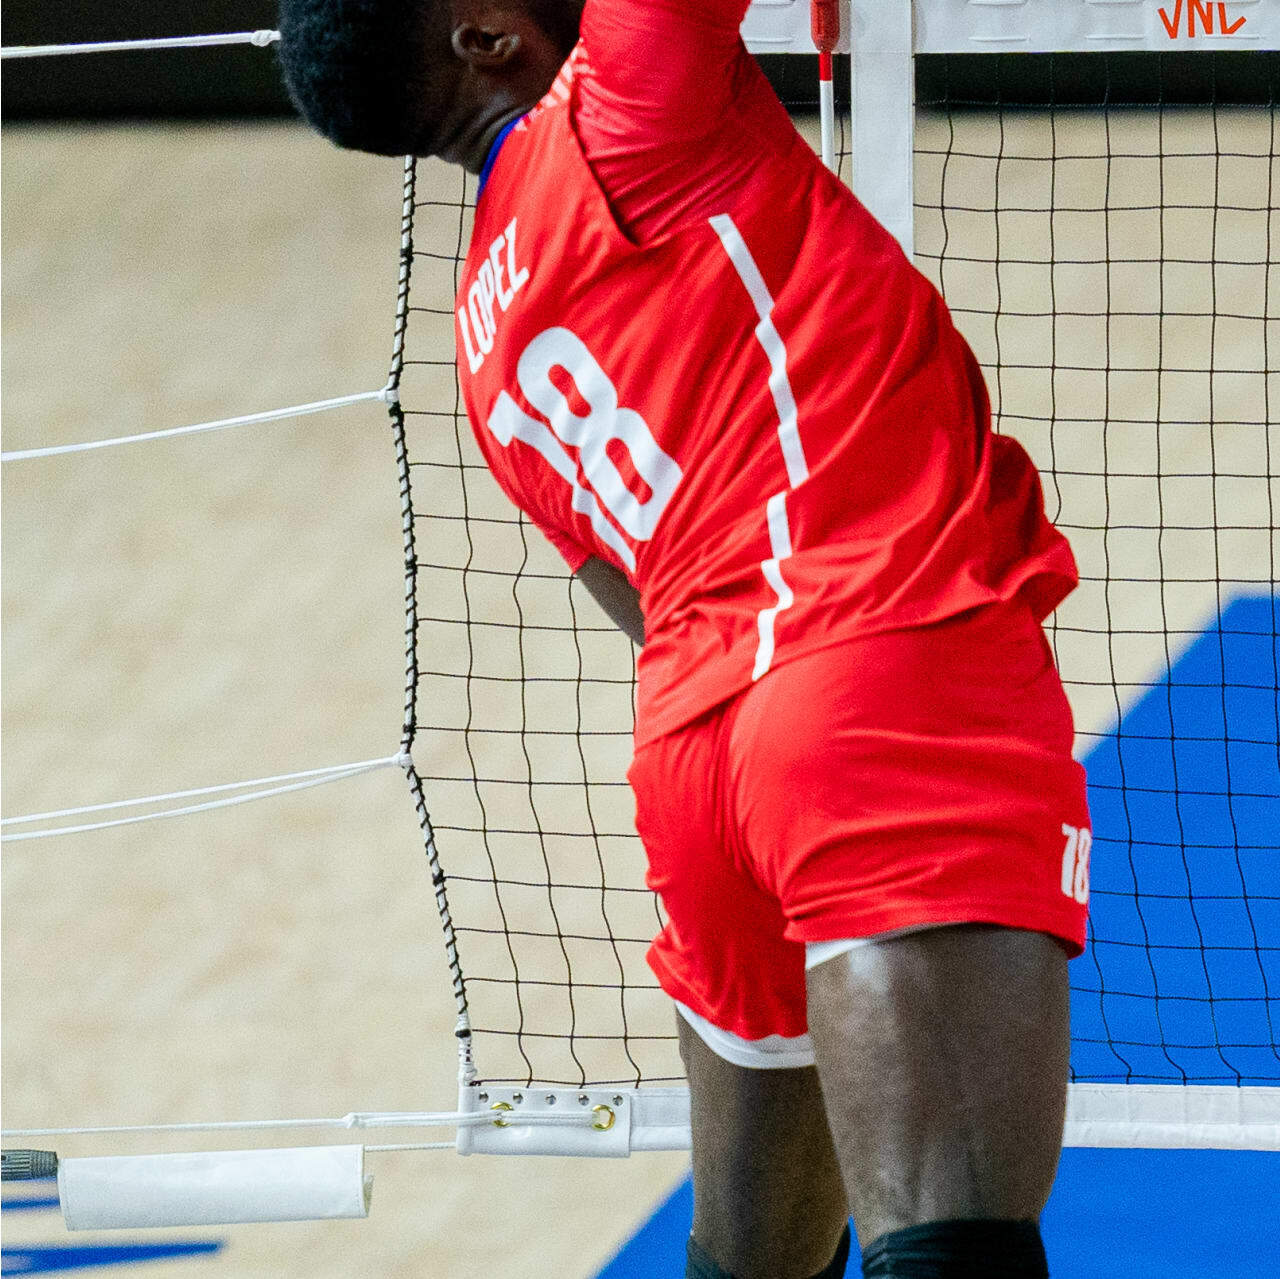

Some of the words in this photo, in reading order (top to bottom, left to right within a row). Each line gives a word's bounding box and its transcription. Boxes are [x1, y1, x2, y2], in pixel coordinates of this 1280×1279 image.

[457, 217, 530, 374] LOPEZ
[487, 326, 684, 573] 18
[1061, 822, 1092, 904] 18
